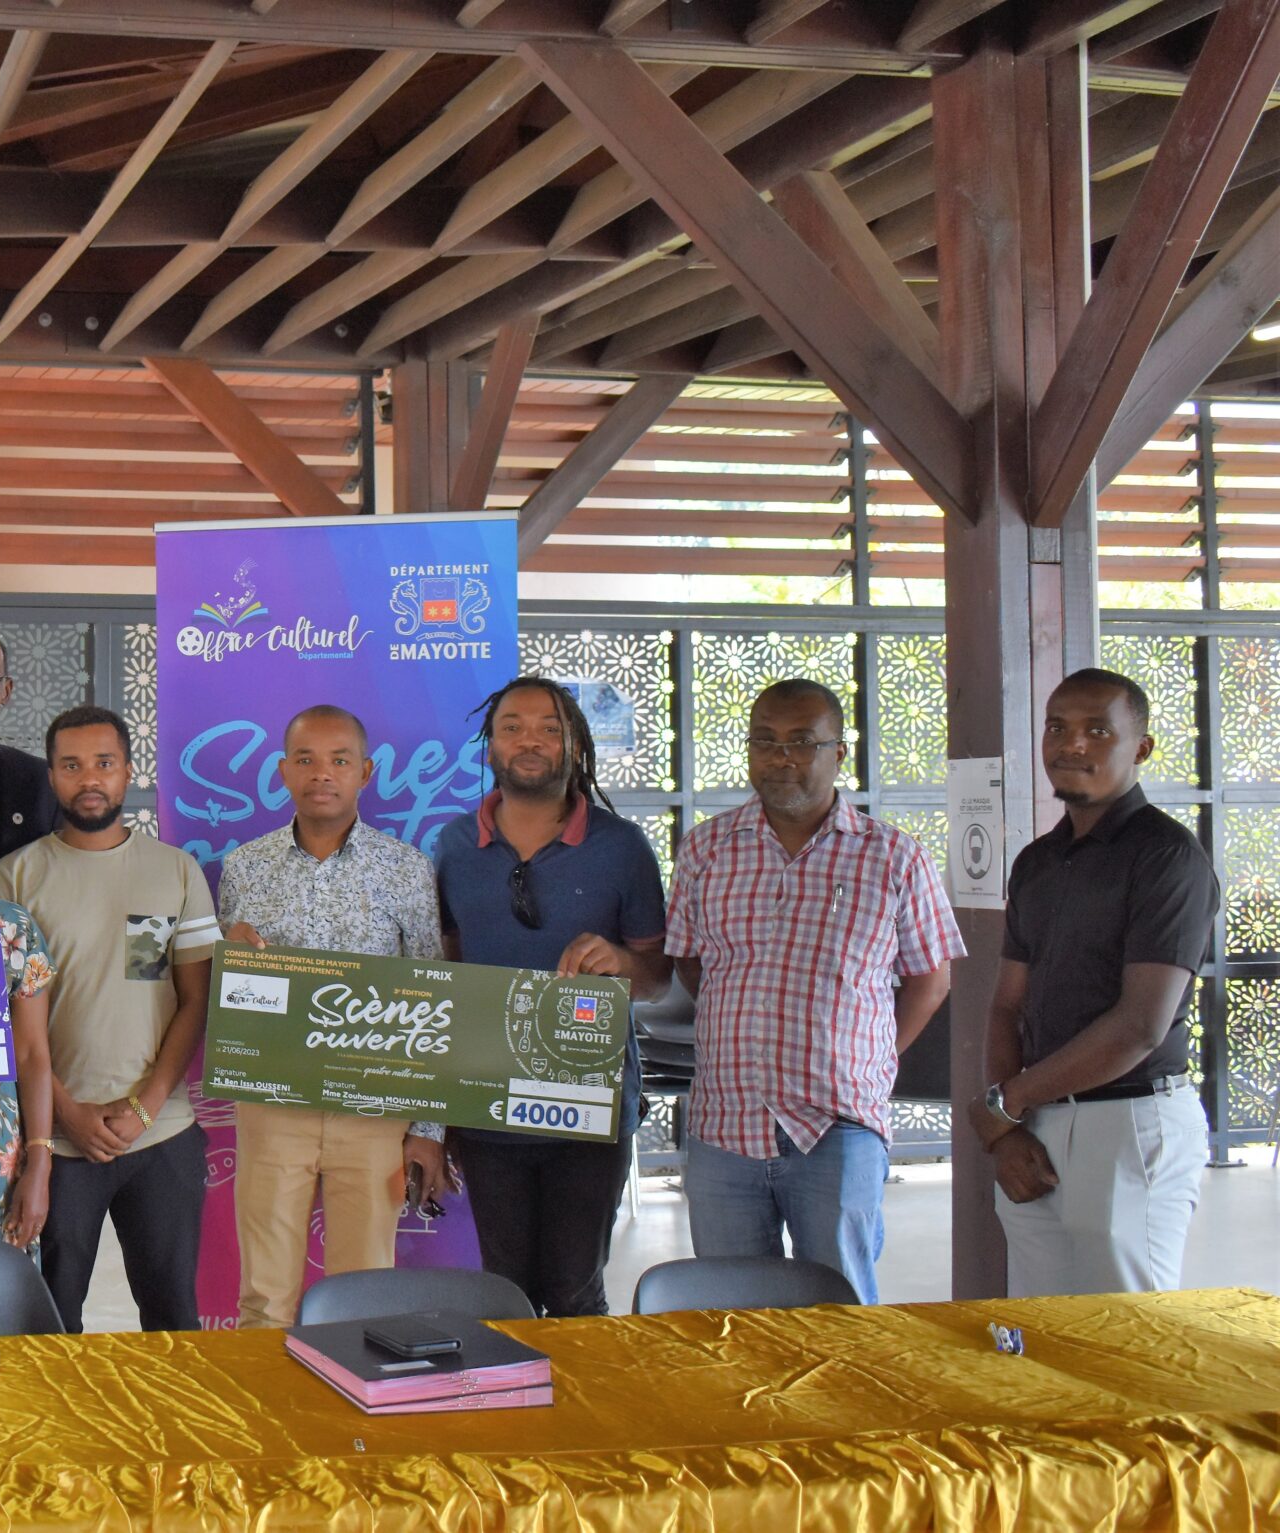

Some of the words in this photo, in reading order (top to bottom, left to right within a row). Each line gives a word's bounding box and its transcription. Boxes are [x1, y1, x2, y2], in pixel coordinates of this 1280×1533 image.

[390, 564, 489, 577] DÉPARTEMENT
[176, 625, 255, 662] Office
[268, 614, 374, 652] Culturel
[298, 651, 354, 661] Départemental
[390, 643, 399, 660] DE
[401, 642, 492, 660] MAYOTTE
[224, 949, 254, 959] CONSEIL
[255, 952, 314, 965] DÉPARTEMENTAL
[326, 960, 361, 969] MAYOTTE
[223, 958, 248, 966] OFFICE
[248, 960, 284, 970] CULTUREL
[284, 963, 344, 976] DÉPARTEMENTAL
[413, 968, 424, 978] 1er
[426, 969, 453, 982] PRIX
[402, 988, 433, 998] ÉDITION
[558, 986, 615, 998] DÉPARTEMENT
[308, 983, 454, 1027] Scènes
[305, 1028, 452, 1060] ouvertes
[561, 1030, 613, 1044] MAYOTTE
[222, 1046, 260, 1056] 21/06/2023
[214, 1067, 247, 1077] Signature
[224, 1078, 239, 1086] Ben
[240, 1080, 254, 1088] Issa
[256, 1081, 291, 1092] OUSSENI
[323, 1080, 356, 1090] Signature
[322, 1089, 341, 1098] Mme
[385, 1096, 429, 1107] MOUAYAD
[430, 1101, 447, 1110] BEN
[511, 1102, 579, 1128] 4000
[582, 1110, 591, 1130] Euros
